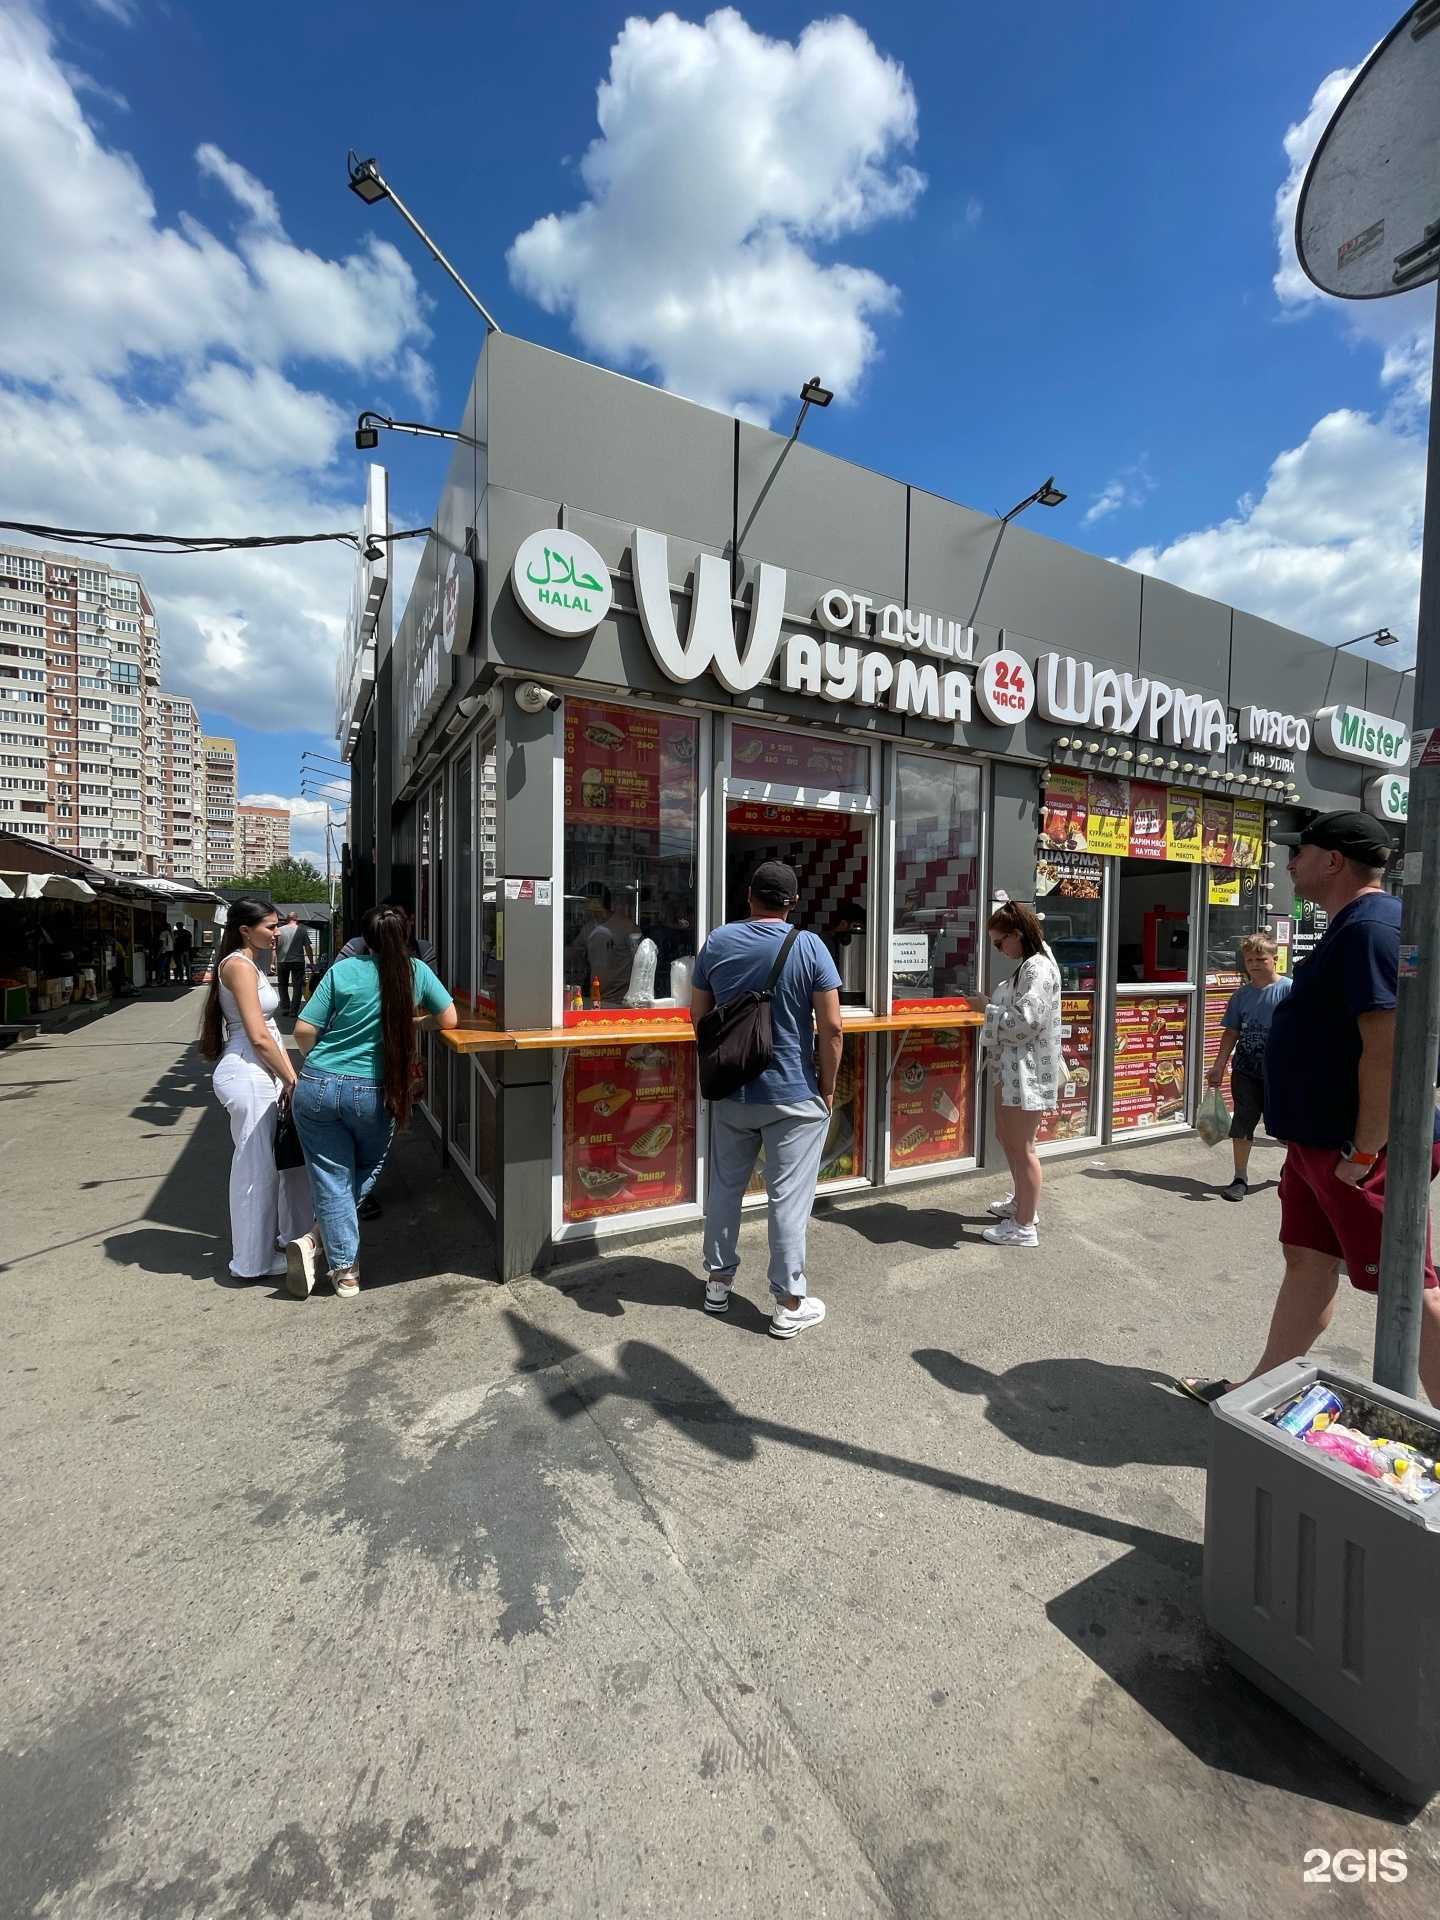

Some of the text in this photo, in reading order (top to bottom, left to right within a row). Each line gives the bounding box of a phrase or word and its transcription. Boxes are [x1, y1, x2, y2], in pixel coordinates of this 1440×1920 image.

[526, 546, 604, 593] حلال
[538, 587, 593, 613] HALAL
[818, 588, 974, 662] ОТ ДУШИ
[994, 660, 1026, 693] 24
[992, 690, 1026, 711] ЧАСА
[1042, 653, 1227, 754] ШАУРМА
[1247, 706, 1310, 752] МЯСО
[1339, 712, 1405, 760] Mister
[1252, 752, 1295, 774] НА УГЛЯХ
